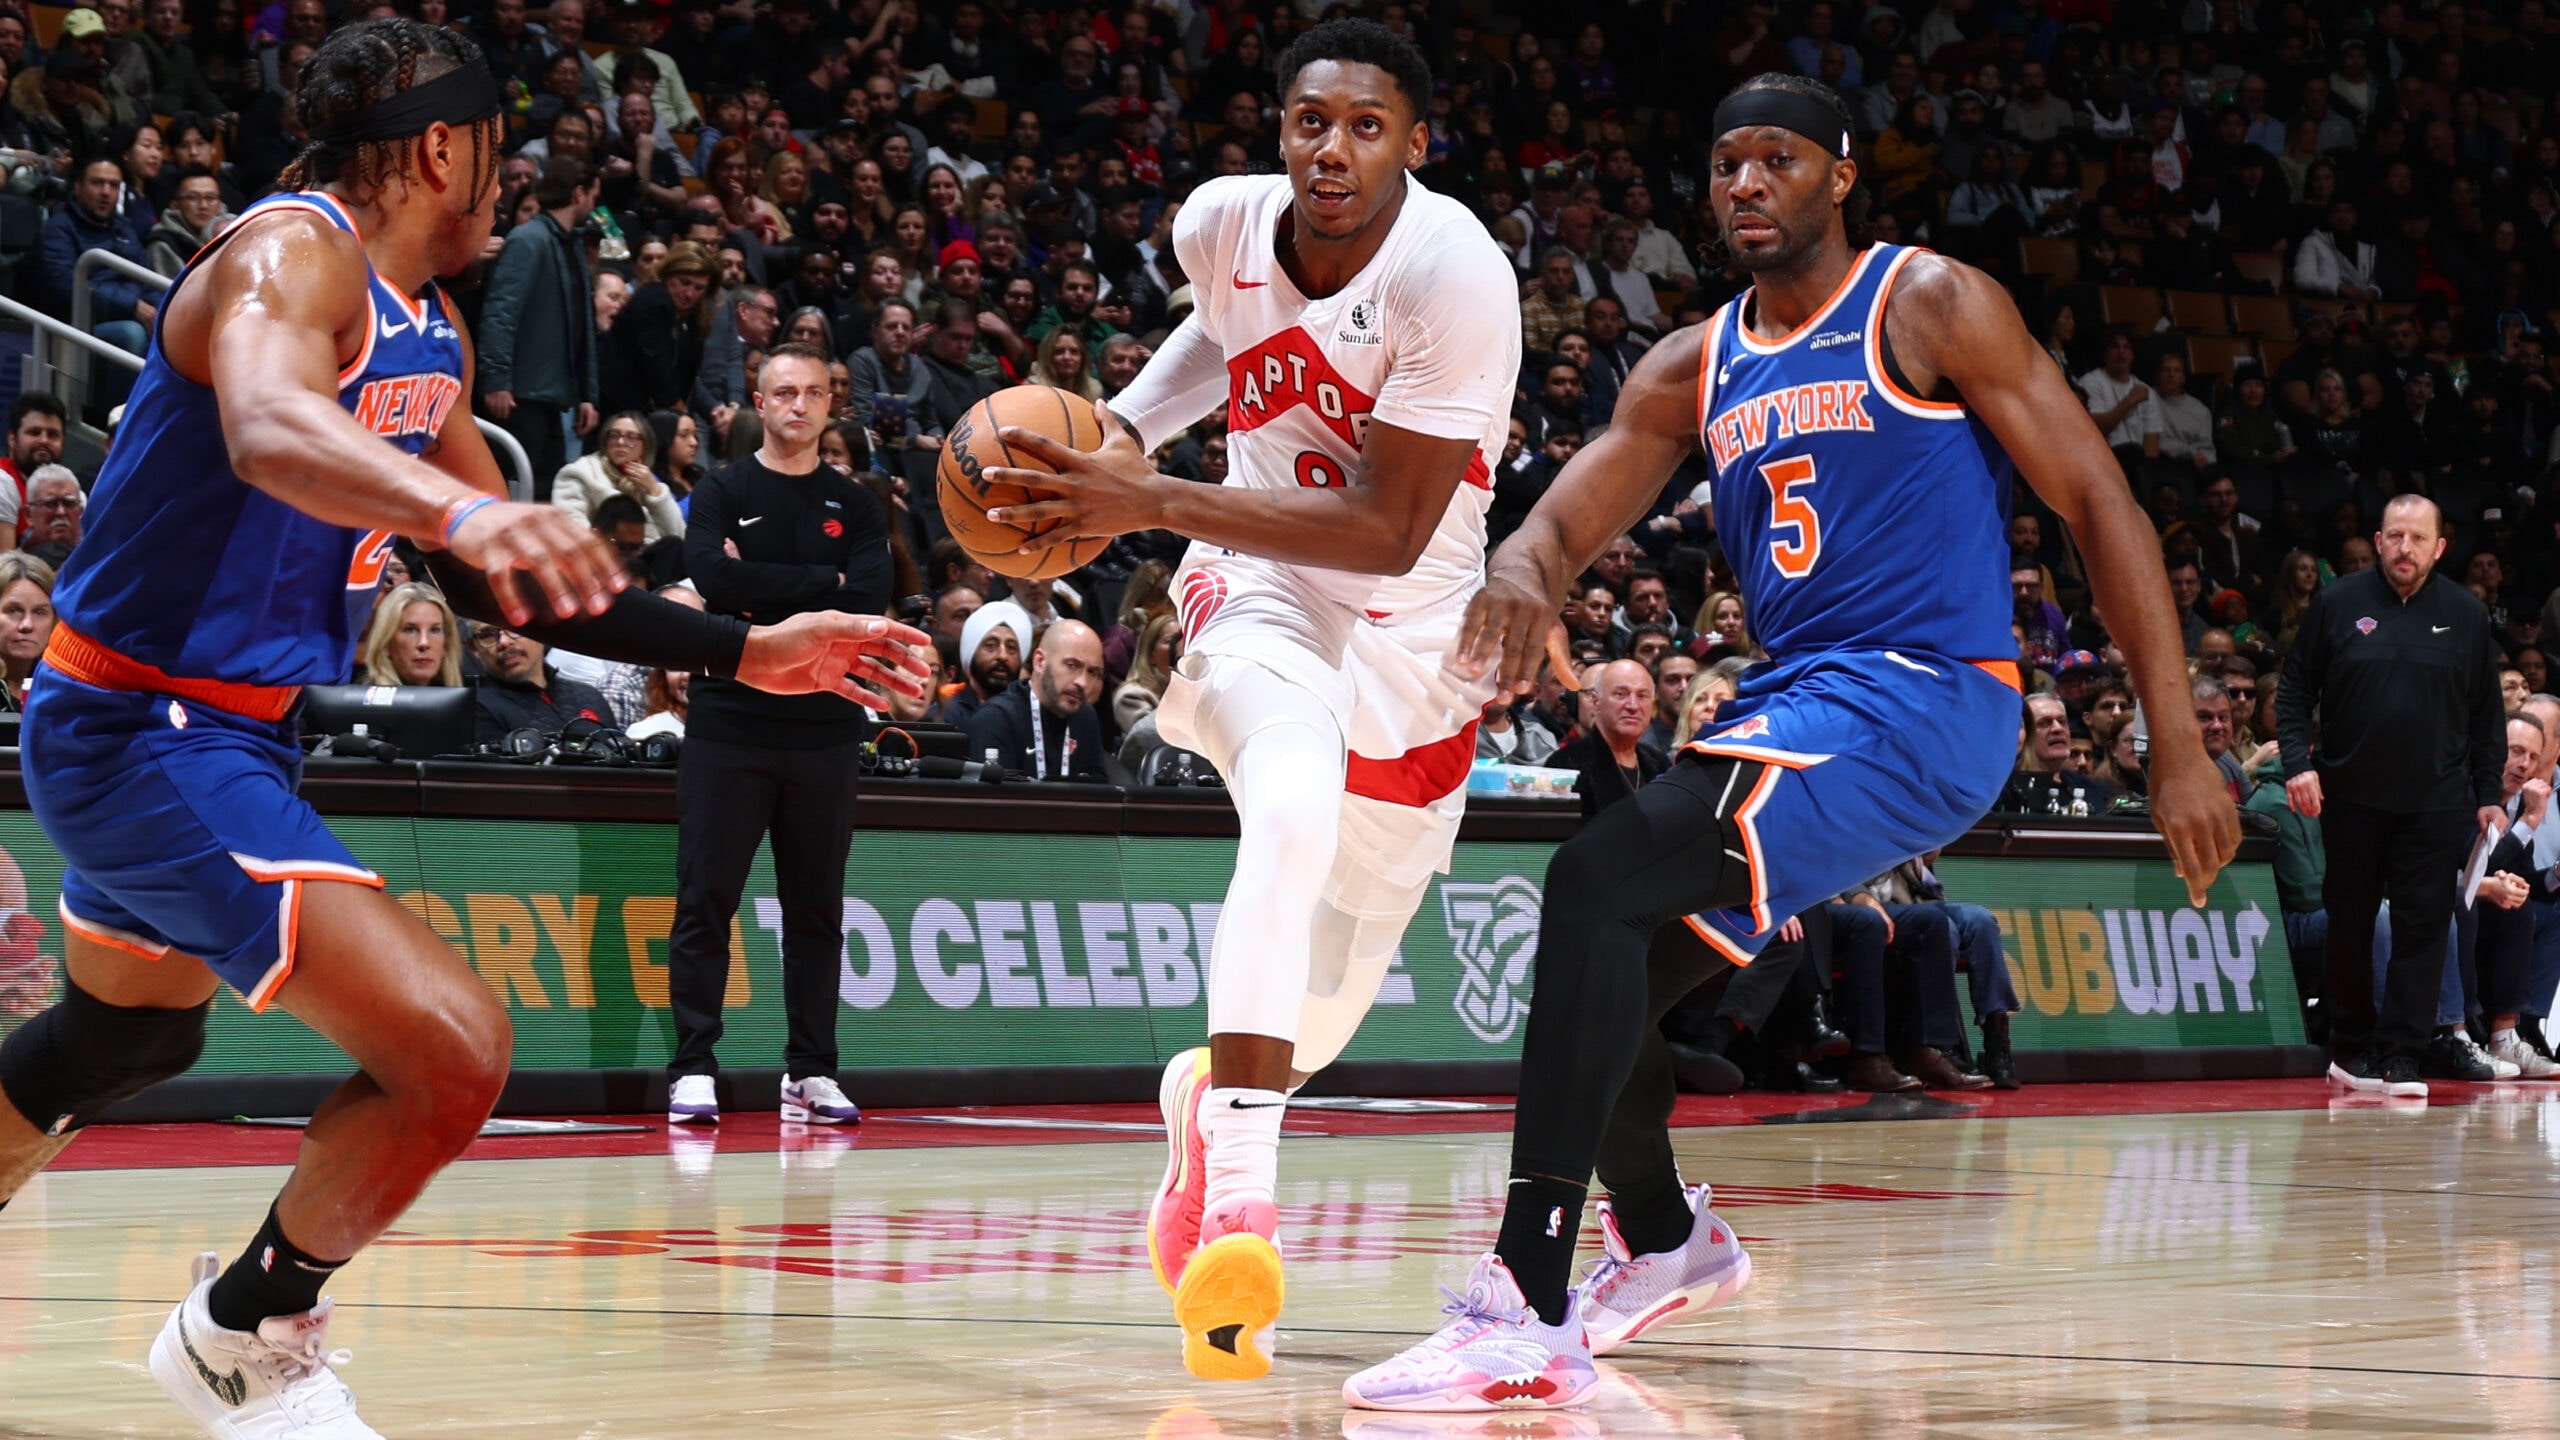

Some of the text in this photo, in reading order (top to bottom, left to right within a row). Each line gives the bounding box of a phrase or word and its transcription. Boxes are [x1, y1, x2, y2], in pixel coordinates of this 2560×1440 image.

[1338, 330, 1382, 345] Sun Life
[1239, 352, 1371, 445] APTOR
[1772, 380, 1875, 441] YORK
[950, 408, 992, 499] ilson
[1758, 453, 1822, 579] 5
